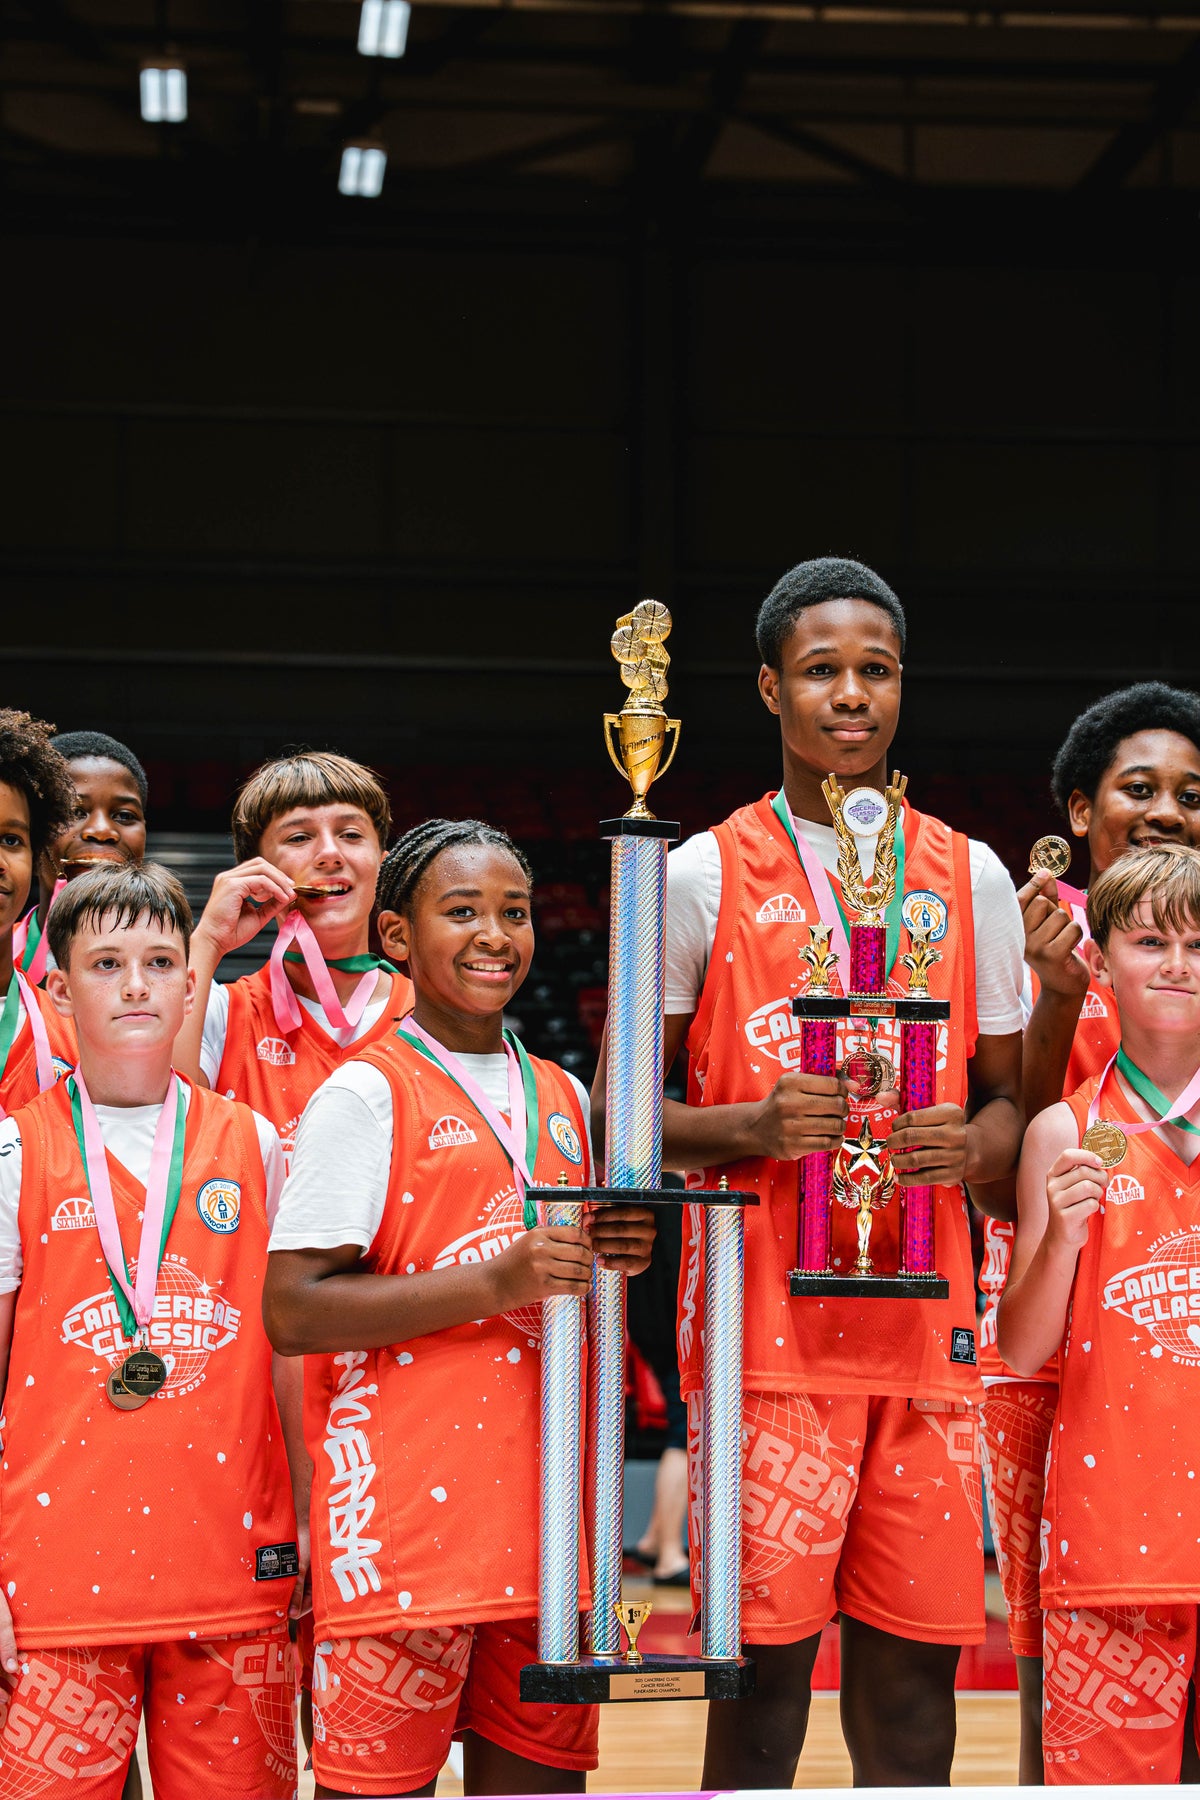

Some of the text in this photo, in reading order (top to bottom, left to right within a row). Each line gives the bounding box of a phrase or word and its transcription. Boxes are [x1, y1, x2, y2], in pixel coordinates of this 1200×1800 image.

[761, 910, 801, 921] SIXTH MAN
[433, 1131, 473, 1147] SIXTH MAN
[483, 1184, 516, 1213] WILL
[57, 1214, 97, 1229] SIXTH MA
[203, 1210, 227, 1229] LONDON
[165, 1253, 188, 1266] ISE
[62, 1296, 241, 1341] CANERBAE
[1132, 1294, 1200, 1326] CLAS
[92, 1322, 219, 1357] CLASSIC
[179, 1374, 206, 1396] 2023
[628, 1607, 641, 1624] 1ST
[328, 1739, 387, 1757] 2023
[1046, 1749, 1080, 1763] 023
[264, 1752, 298, 1782] SINC
